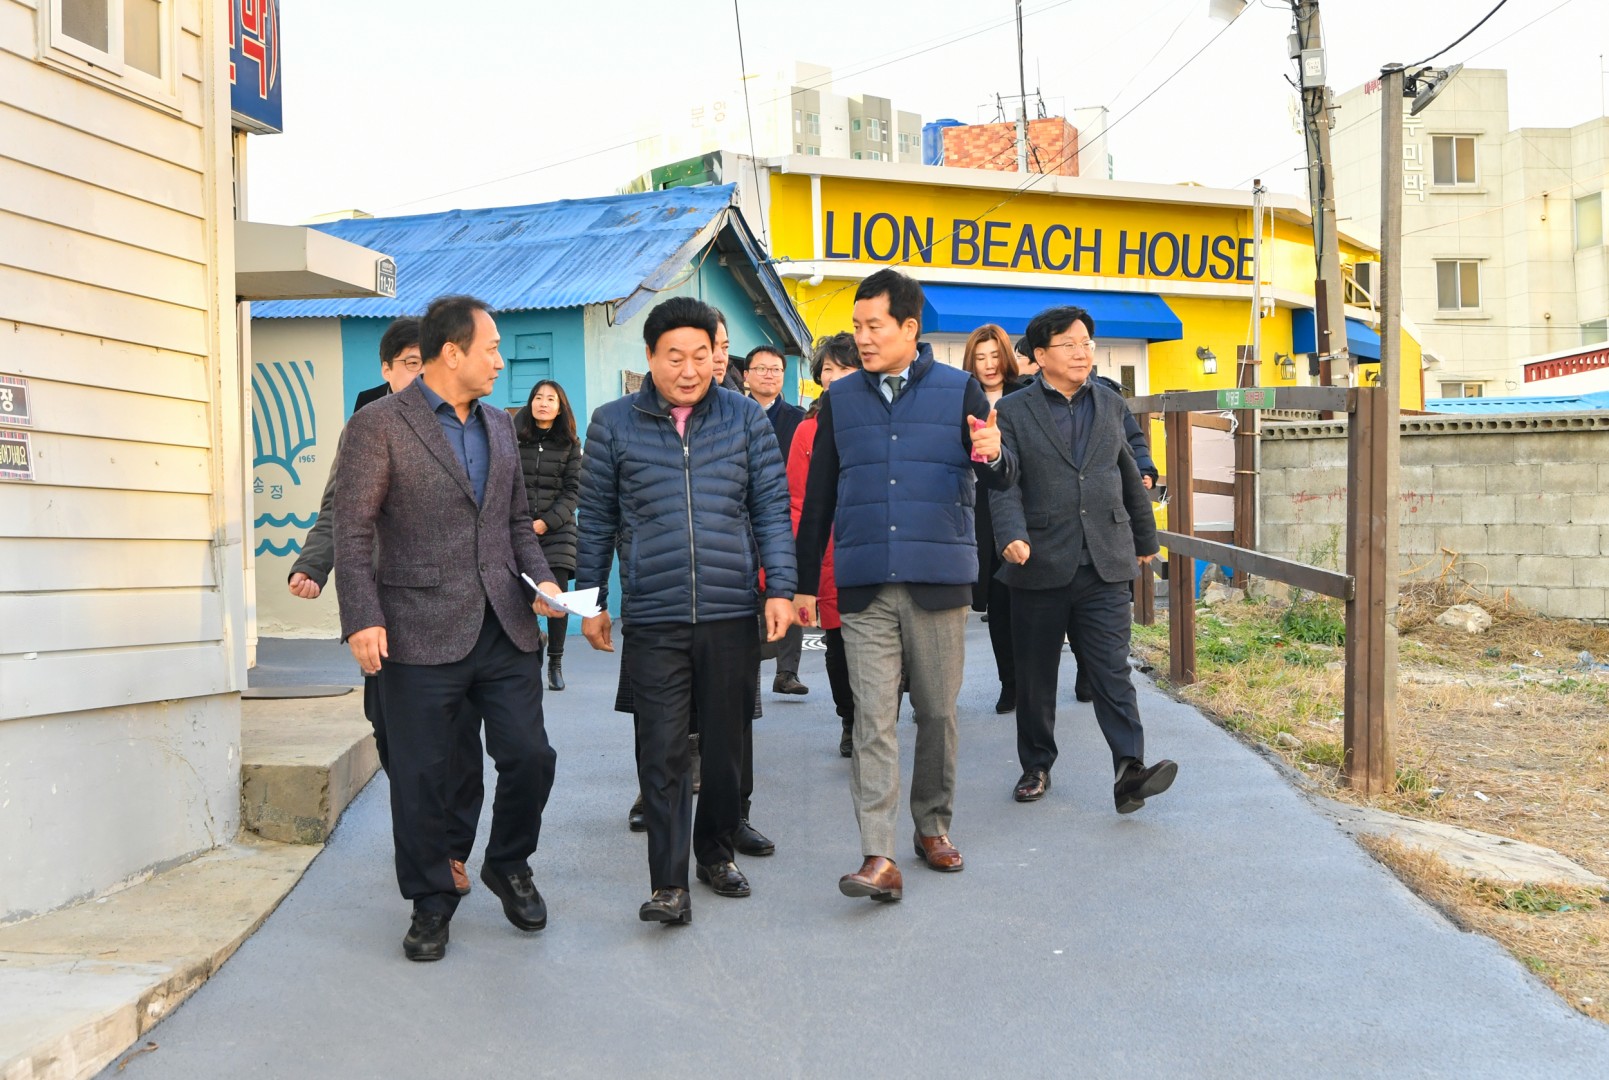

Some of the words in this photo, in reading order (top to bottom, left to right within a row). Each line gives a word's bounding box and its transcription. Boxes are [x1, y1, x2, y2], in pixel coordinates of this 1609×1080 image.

[825, 211, 934, 264] LION
[951, 218, 1102, 274] BEACH
[1118, 230, 1262, 281] HOUSE
[380, 275, 394, 296] 11-22
[299, 455, 316, 464] 1965
[253, 476, 283, 500] 송정
